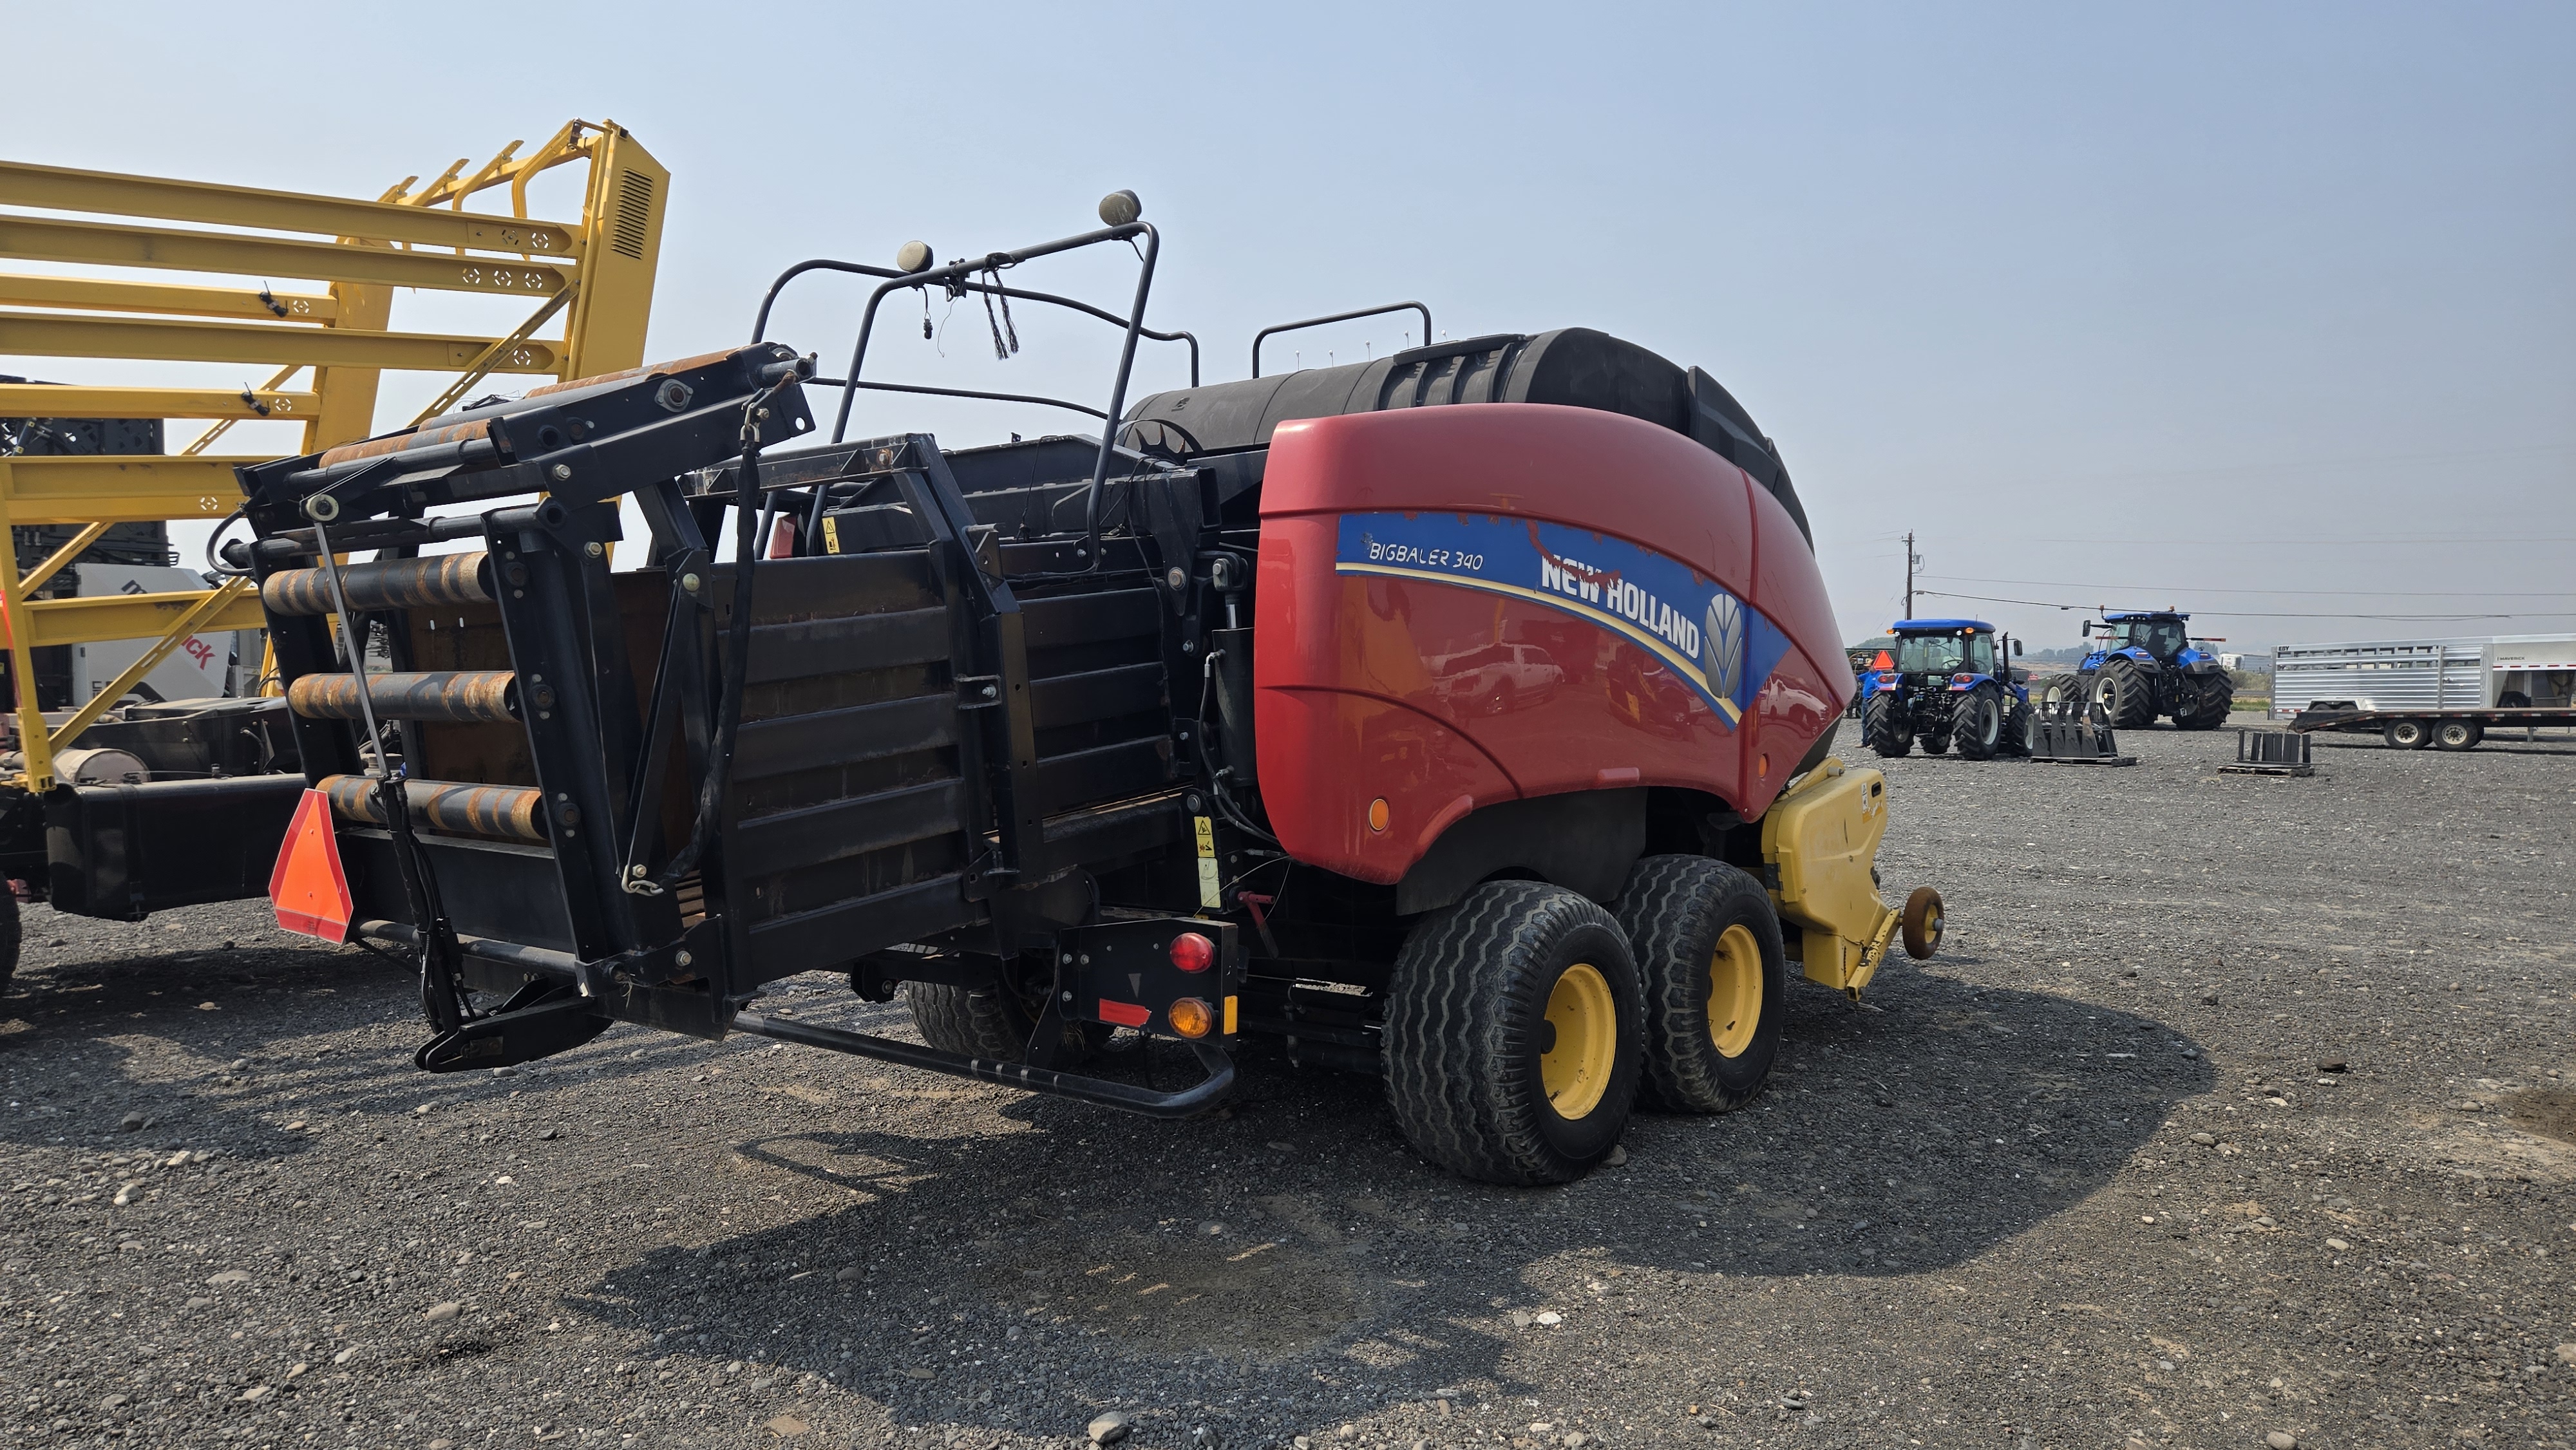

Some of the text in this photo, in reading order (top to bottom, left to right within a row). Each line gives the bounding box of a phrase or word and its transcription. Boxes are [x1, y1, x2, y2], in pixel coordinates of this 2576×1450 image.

[1369, 542, 1484, 570] BIGBALER 340
[1542, 554, 1700, 659] NEW HOLLAND
